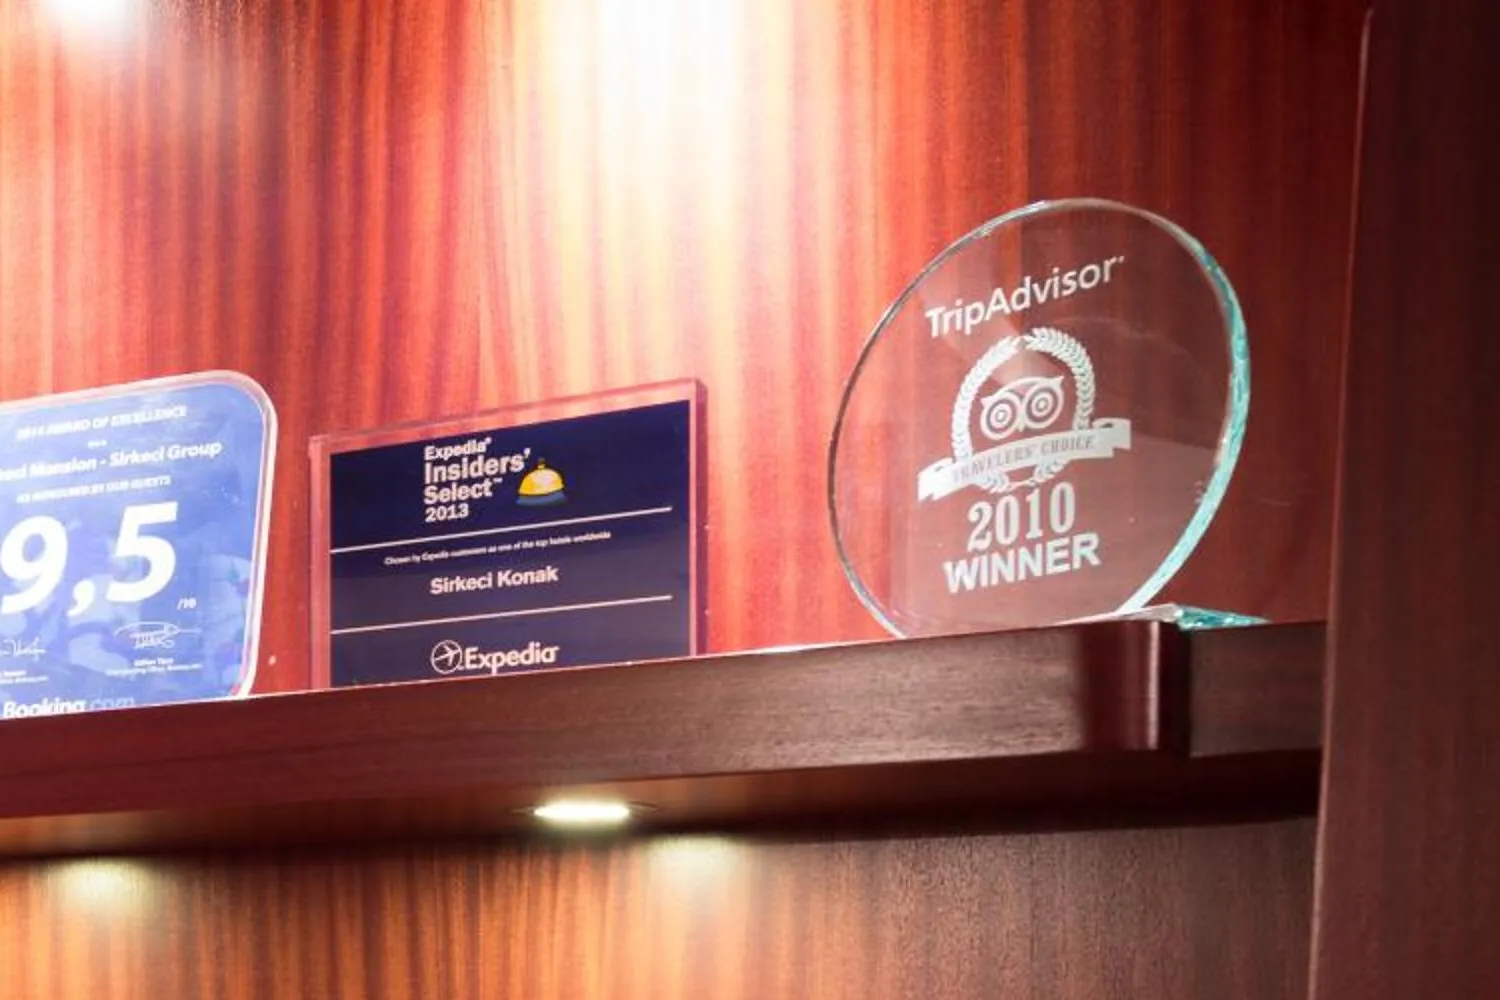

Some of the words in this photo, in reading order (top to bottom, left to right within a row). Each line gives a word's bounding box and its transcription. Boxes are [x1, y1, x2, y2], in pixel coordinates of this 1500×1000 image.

[925, 256, 1117, 338] TripAdvisor
[109, 447, 165, 468] Sirkeci
[167, 441, 223, 460] Group
[1040, 434, 1096, 456] CHOICE
[424, 447, 531, 485] Insiders'
[423, 480, 493, 506] Select
[425, 502, 470, 523] 2013
[967, 481, 1076, 553] 2010
[0, 501, 178, 617] 9,5
[943, 531, 1100, 594] WINNER
[430, 570, 492, 596] Sirkeci
[497, 565, 559, 589] Konak
[464, 640, 557, 676] Expedia
